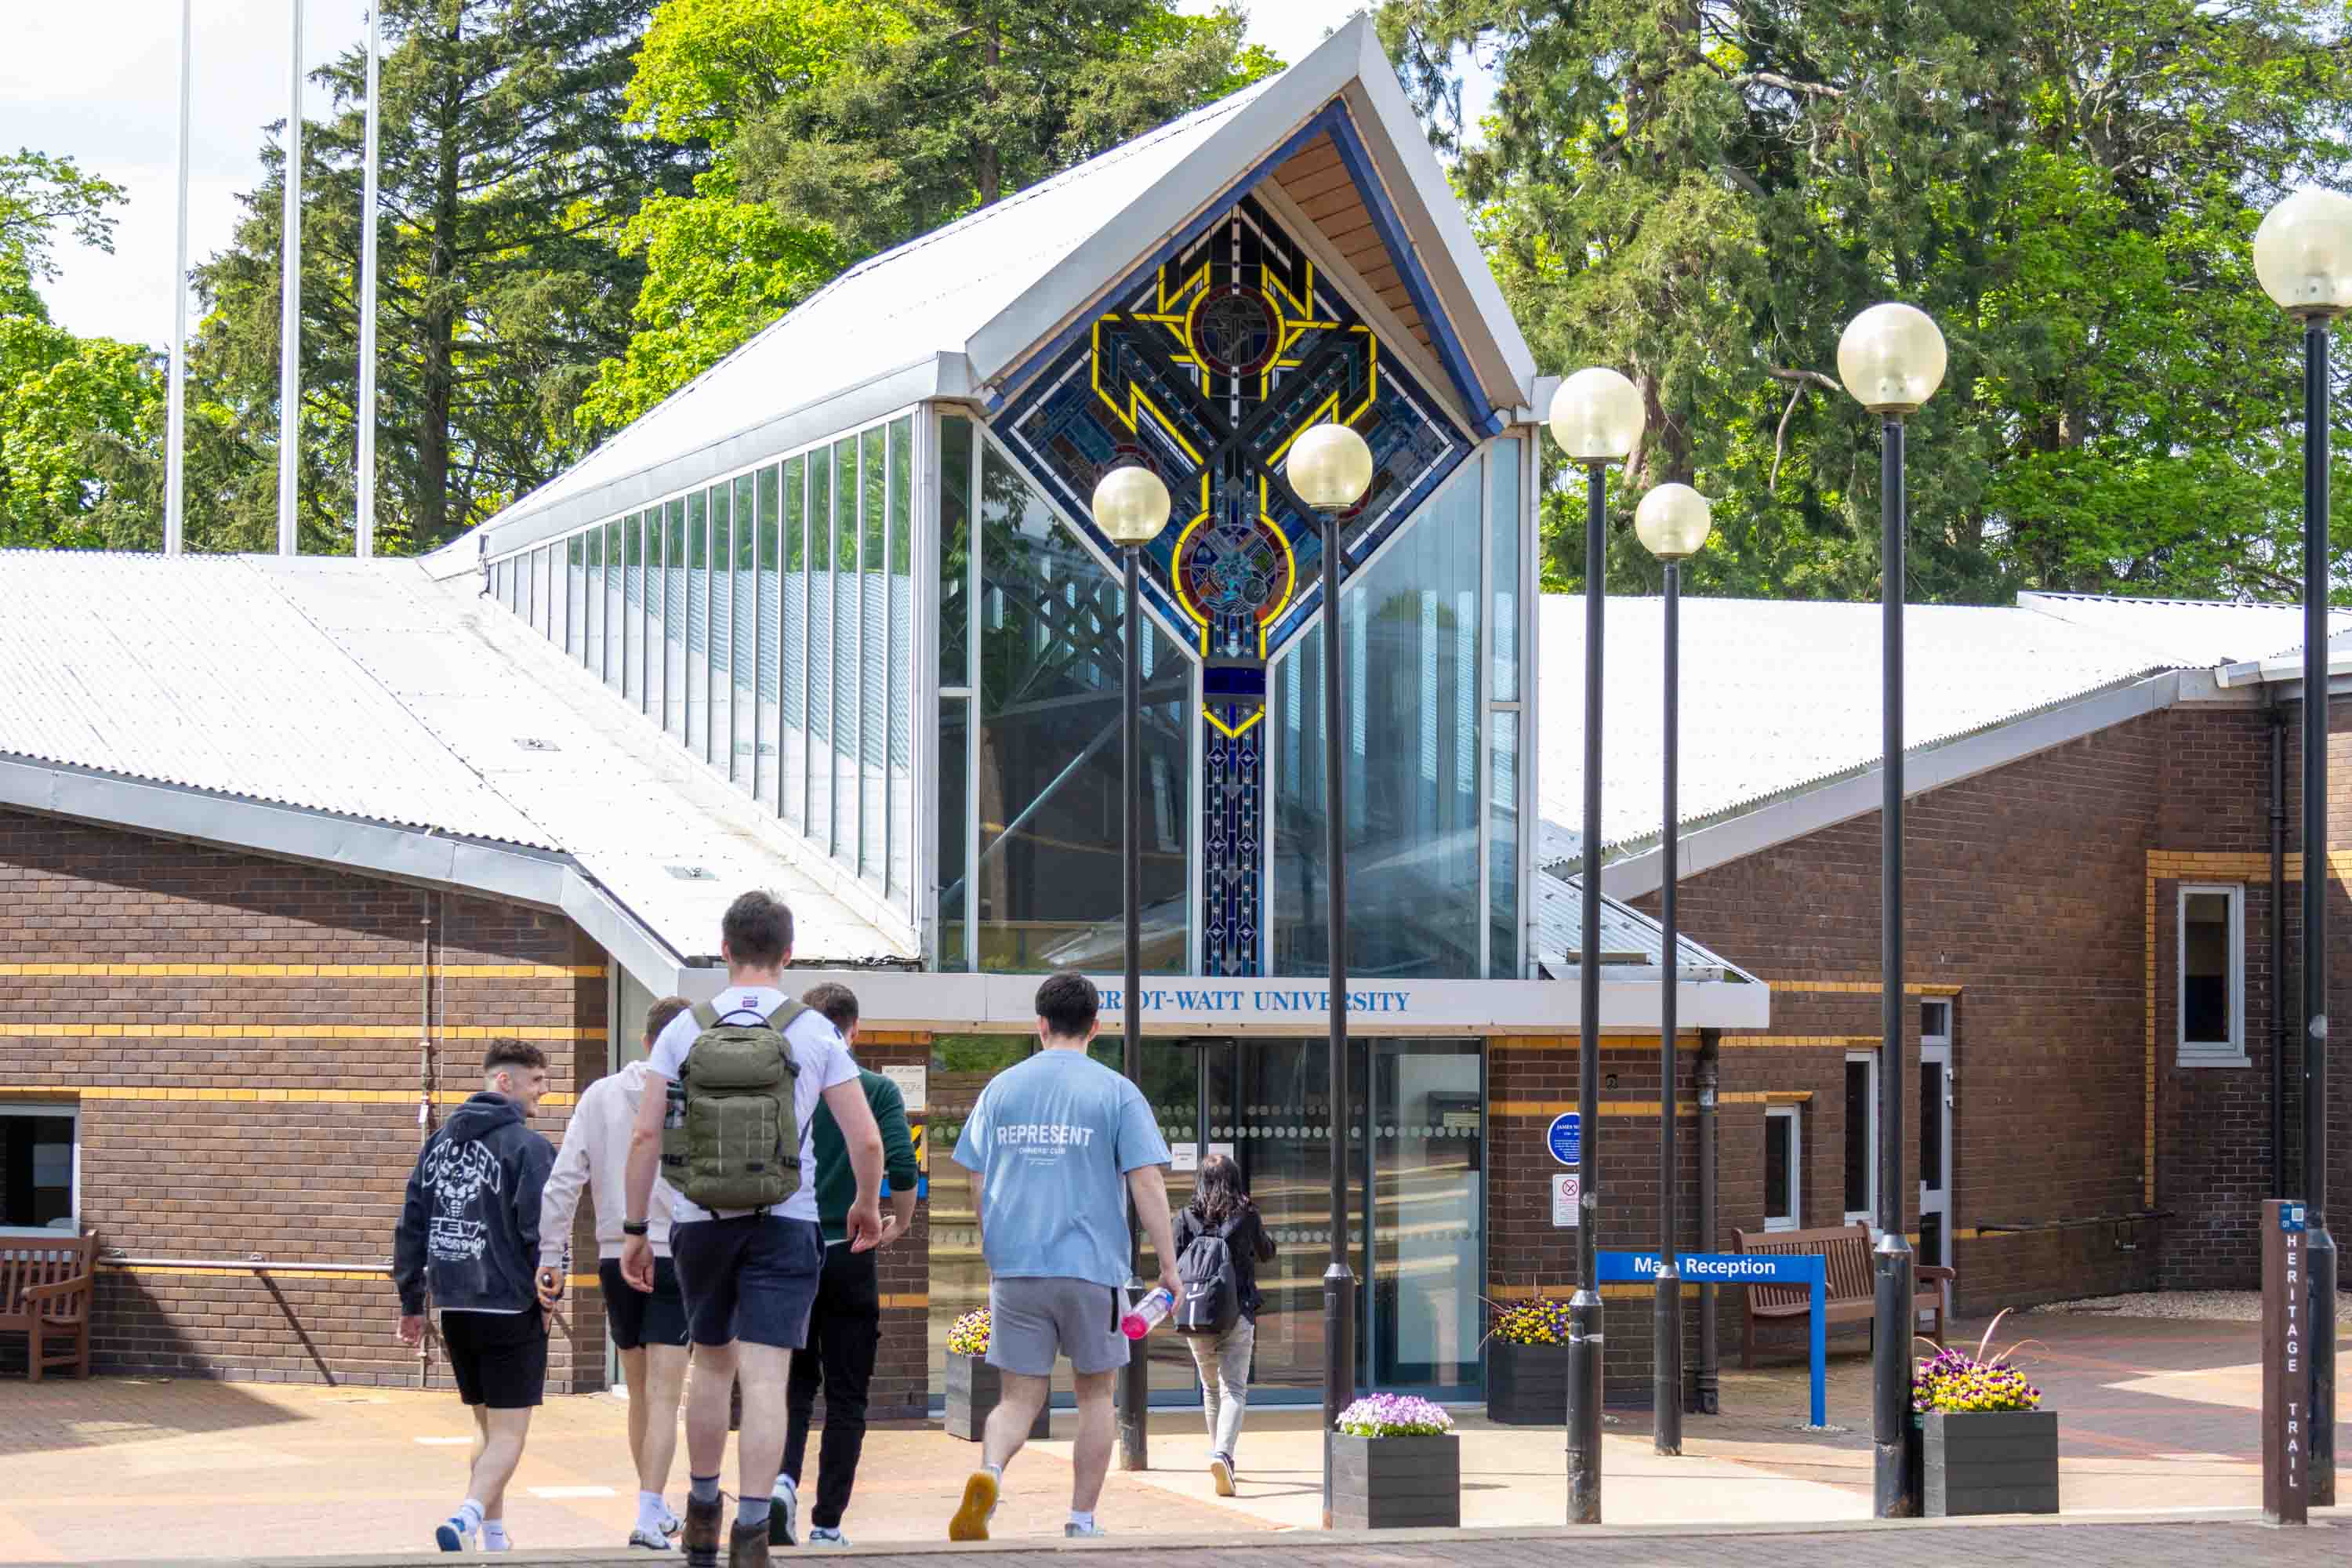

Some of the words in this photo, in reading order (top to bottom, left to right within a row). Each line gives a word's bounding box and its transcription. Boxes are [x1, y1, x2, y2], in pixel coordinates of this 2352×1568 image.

[996, 1123, 1095, 1146] REPRESENT
[422, 1138, 501, 1194] CHOSEN
[1635, 1257, 1680, 1272] Ma
[1686, 1258, 1776, 1277] Reception
[2286, 1235, 2299, 1372] HERITAGE
[2288, 1403, 2299, 1487] TRAIL
